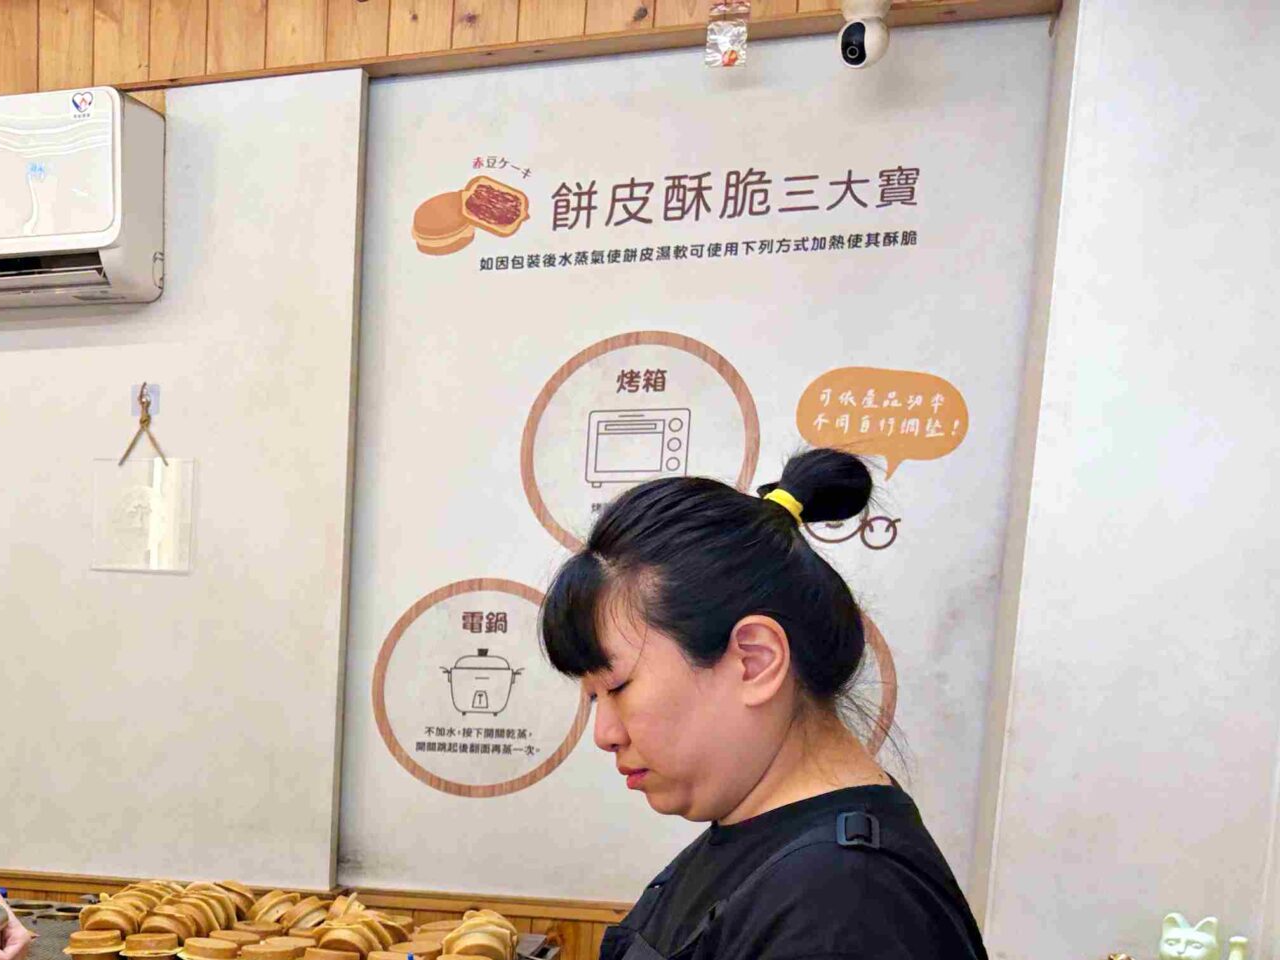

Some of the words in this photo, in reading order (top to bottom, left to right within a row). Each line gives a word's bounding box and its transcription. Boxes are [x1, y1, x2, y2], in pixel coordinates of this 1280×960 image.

[472, 155, 533, 180] 赤豆ケーキ
[549, 165, 921, 232] 餅皮酥脆三大寶
[616, 368, 668, 394] 烤箱
[461, 611, 508, 634] 電鍋
